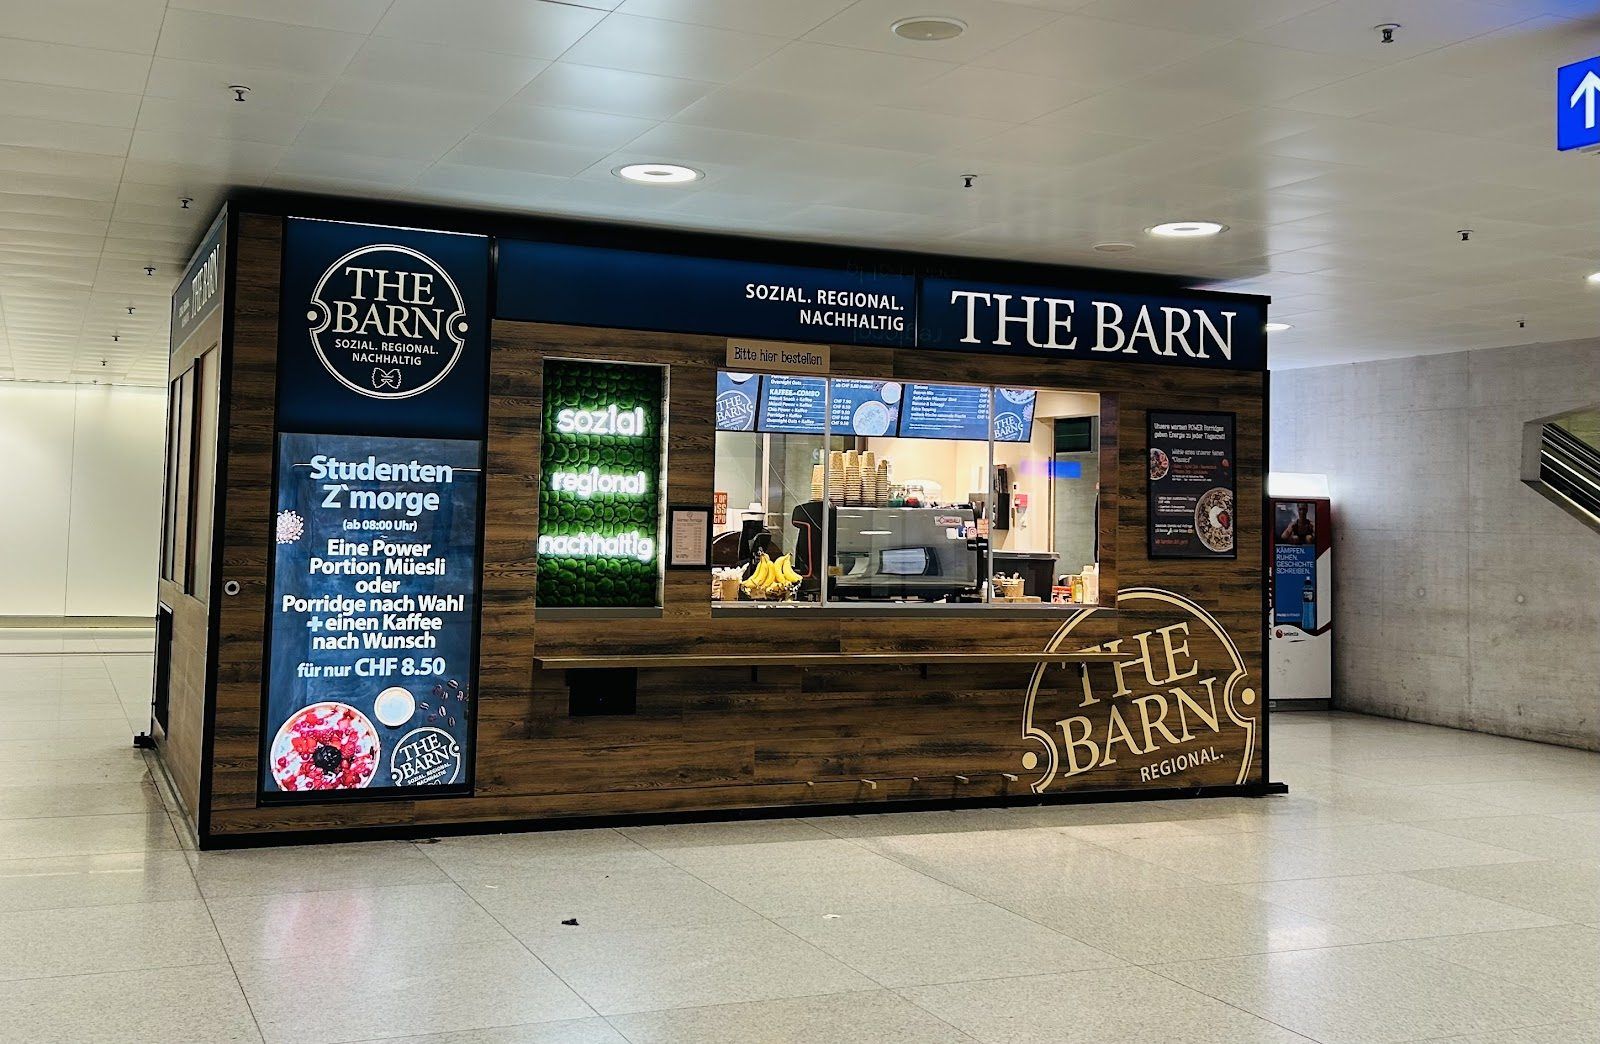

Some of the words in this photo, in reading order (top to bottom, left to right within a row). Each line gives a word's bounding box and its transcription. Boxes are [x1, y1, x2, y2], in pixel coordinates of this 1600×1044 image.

[345, 266, 435, 305] THE
[745, 283, 813, 304] SOZIAL.
[816, 290, 904, 311] REGIONAL.
[332, 300, 445, 341] BARN
[799, 310, 904, 332] NACHHALTIG
[950, 290, 1078, 351] THE
[1090, 301, 1236, 361] BARN
[335, 338, 378, 351] SOZIAL.
[381, 342, 439, 355] REGIONAL.
[734, 346, 757, 361] Bitte
[759, 349, 778, 363] hier
[781, 350, 823, 365] bestellen
[352, 353, 422, 366] NACHHALTIG
[717, 403, 747, 422] BARN
[718, 395, 742, 412] THE
[557, 404, 644, 435] sozial
[994, 416, 1016, 430] THE
[994, 423, 1018, 438] BARN
[309, 454, 453, 483] Studenten
[552, 466, 646, 495] regional
[342, 519, 361, 531] (ab
[362, 520, 393, 531] 08:00
[393, 520, 418, 532] Uhr)
[327, 538, 369, 556] Eine
[372, 540, 431, 557] Power
[538, 530, 654, 562] nachhaltig
[309, 557, 381, 575] Portion
[384, 558, 446, 575] Müesli
[355, 576, 401, 593] oder
[282, 594, 366, 616] Porridge
[369, 595, 415, 612] nach
[418, 594, 465, 612] Wahl
[382, 613, 443, 631] Kaffee
[312, 633, 359, 650] nach
[362, 631, 436, 649] Wunsch
[297, 662, 321, 678] für
[323, 664, 351, 677] nur
[354, 657, 398, 677] CHF
[401, 657, 446, 676] 8.50
[1078, 621, 1198, 707] THE
[1055, 676, 1220, 778] BARN
[399, 733, 441, 762] THE
[400, 745, 449, 779] BARN
[1139, 746, 1224, 783] REGIONAL.
